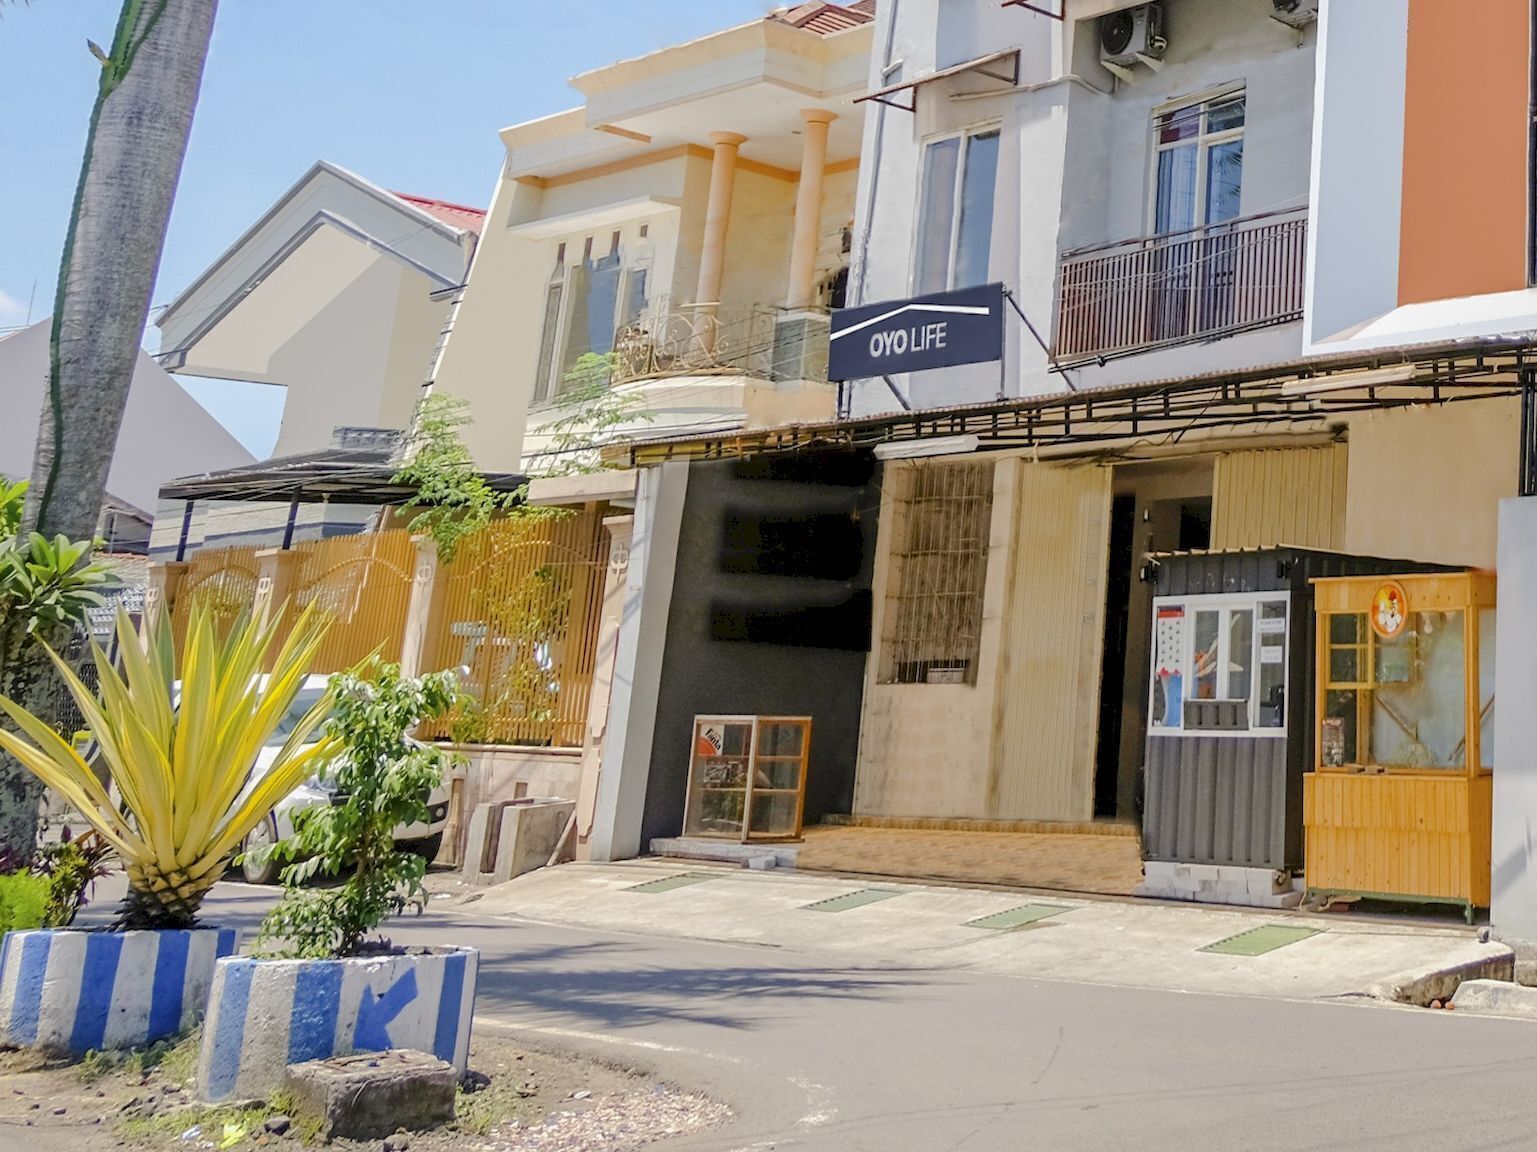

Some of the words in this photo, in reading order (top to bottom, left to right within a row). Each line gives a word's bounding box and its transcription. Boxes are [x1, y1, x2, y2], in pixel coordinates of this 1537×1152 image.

[870, 329, 908, 358] OYO
[911, 322, 947, 352] LIFE
[705, 728, 721, 750] Fanta
